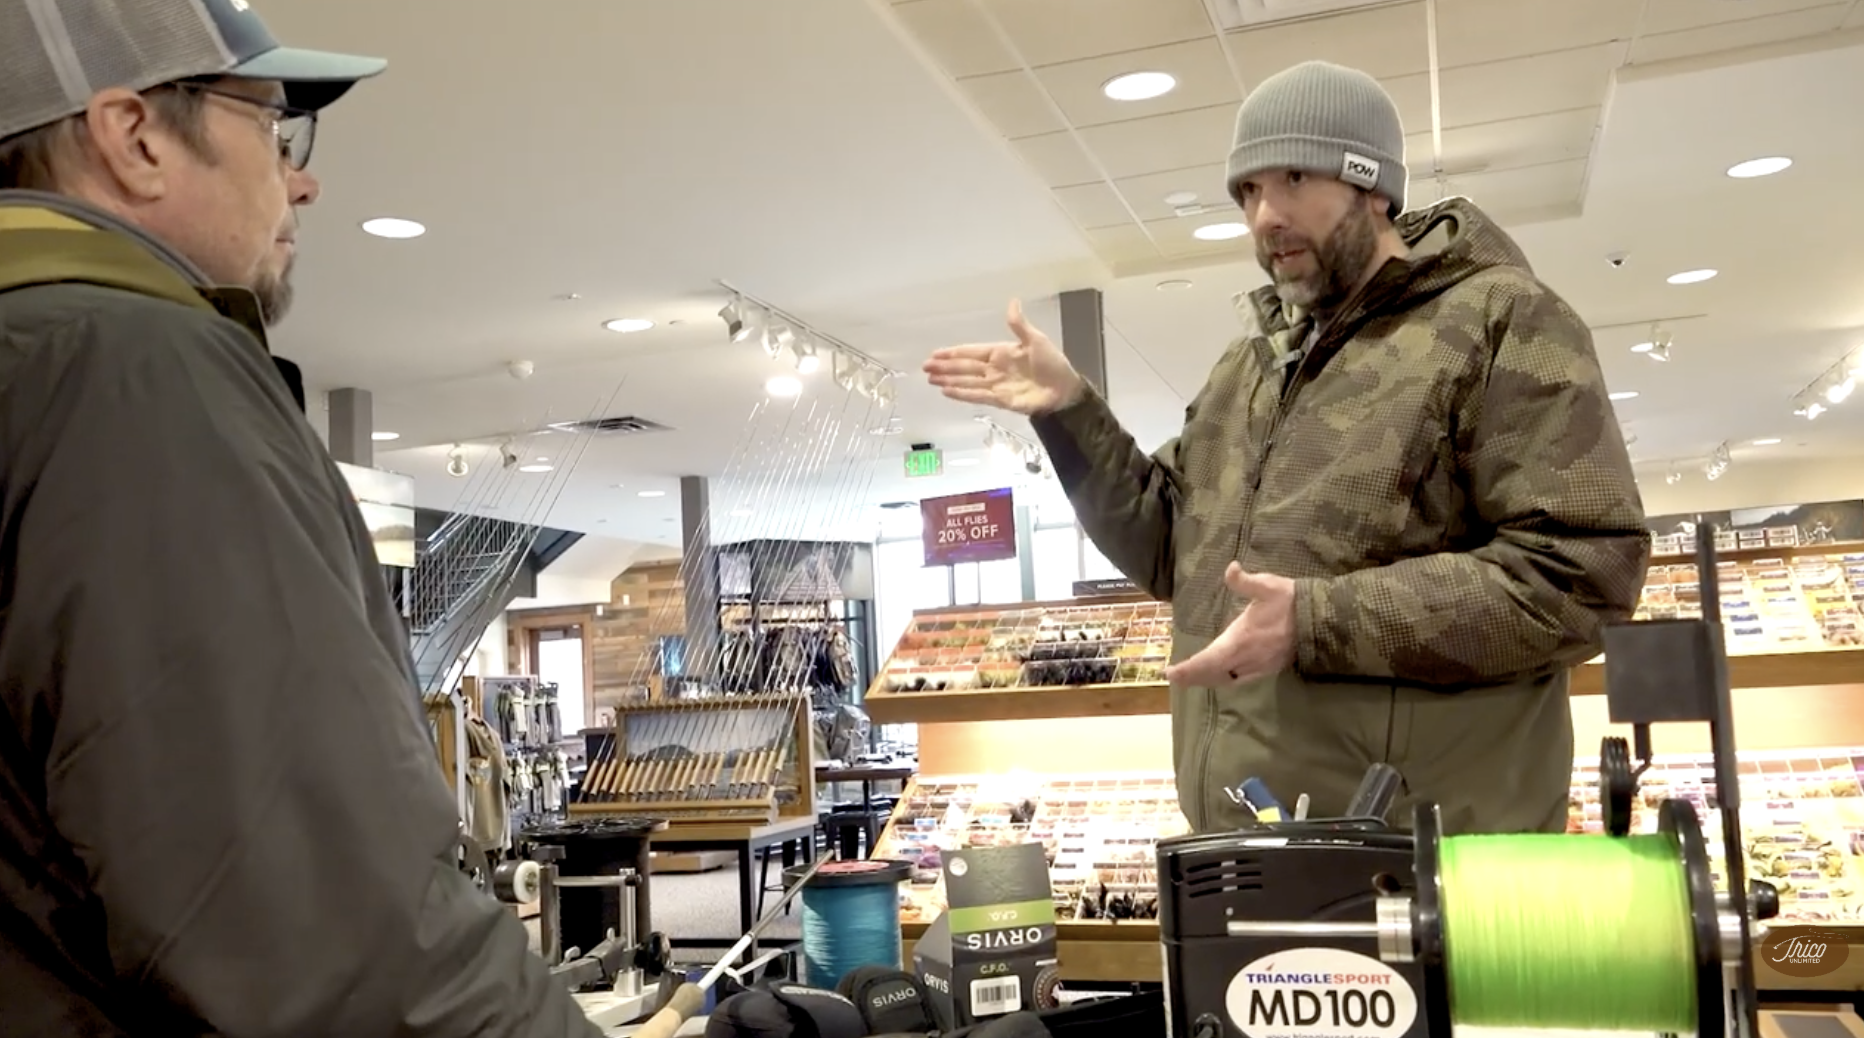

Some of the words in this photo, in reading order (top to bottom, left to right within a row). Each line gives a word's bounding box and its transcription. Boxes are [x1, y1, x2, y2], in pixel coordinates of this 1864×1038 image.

[1347, 161, 1376, 177] POW
[946, 518, 962, 527] ALL
[964, 514, 988, 525] FLIES
[938, 528, 967, 543] 20%
[970, 524, 998, 539] OFF
[967, 927, 1042, 950] ORVIS
[924, 972, 949, 994] ORVIS
[1246, 973, 1392, 985] TRIANGLESPORT
[872, 987, 917, 1007] ORVIS
[1249, 989, 1396, 1028] MD100
